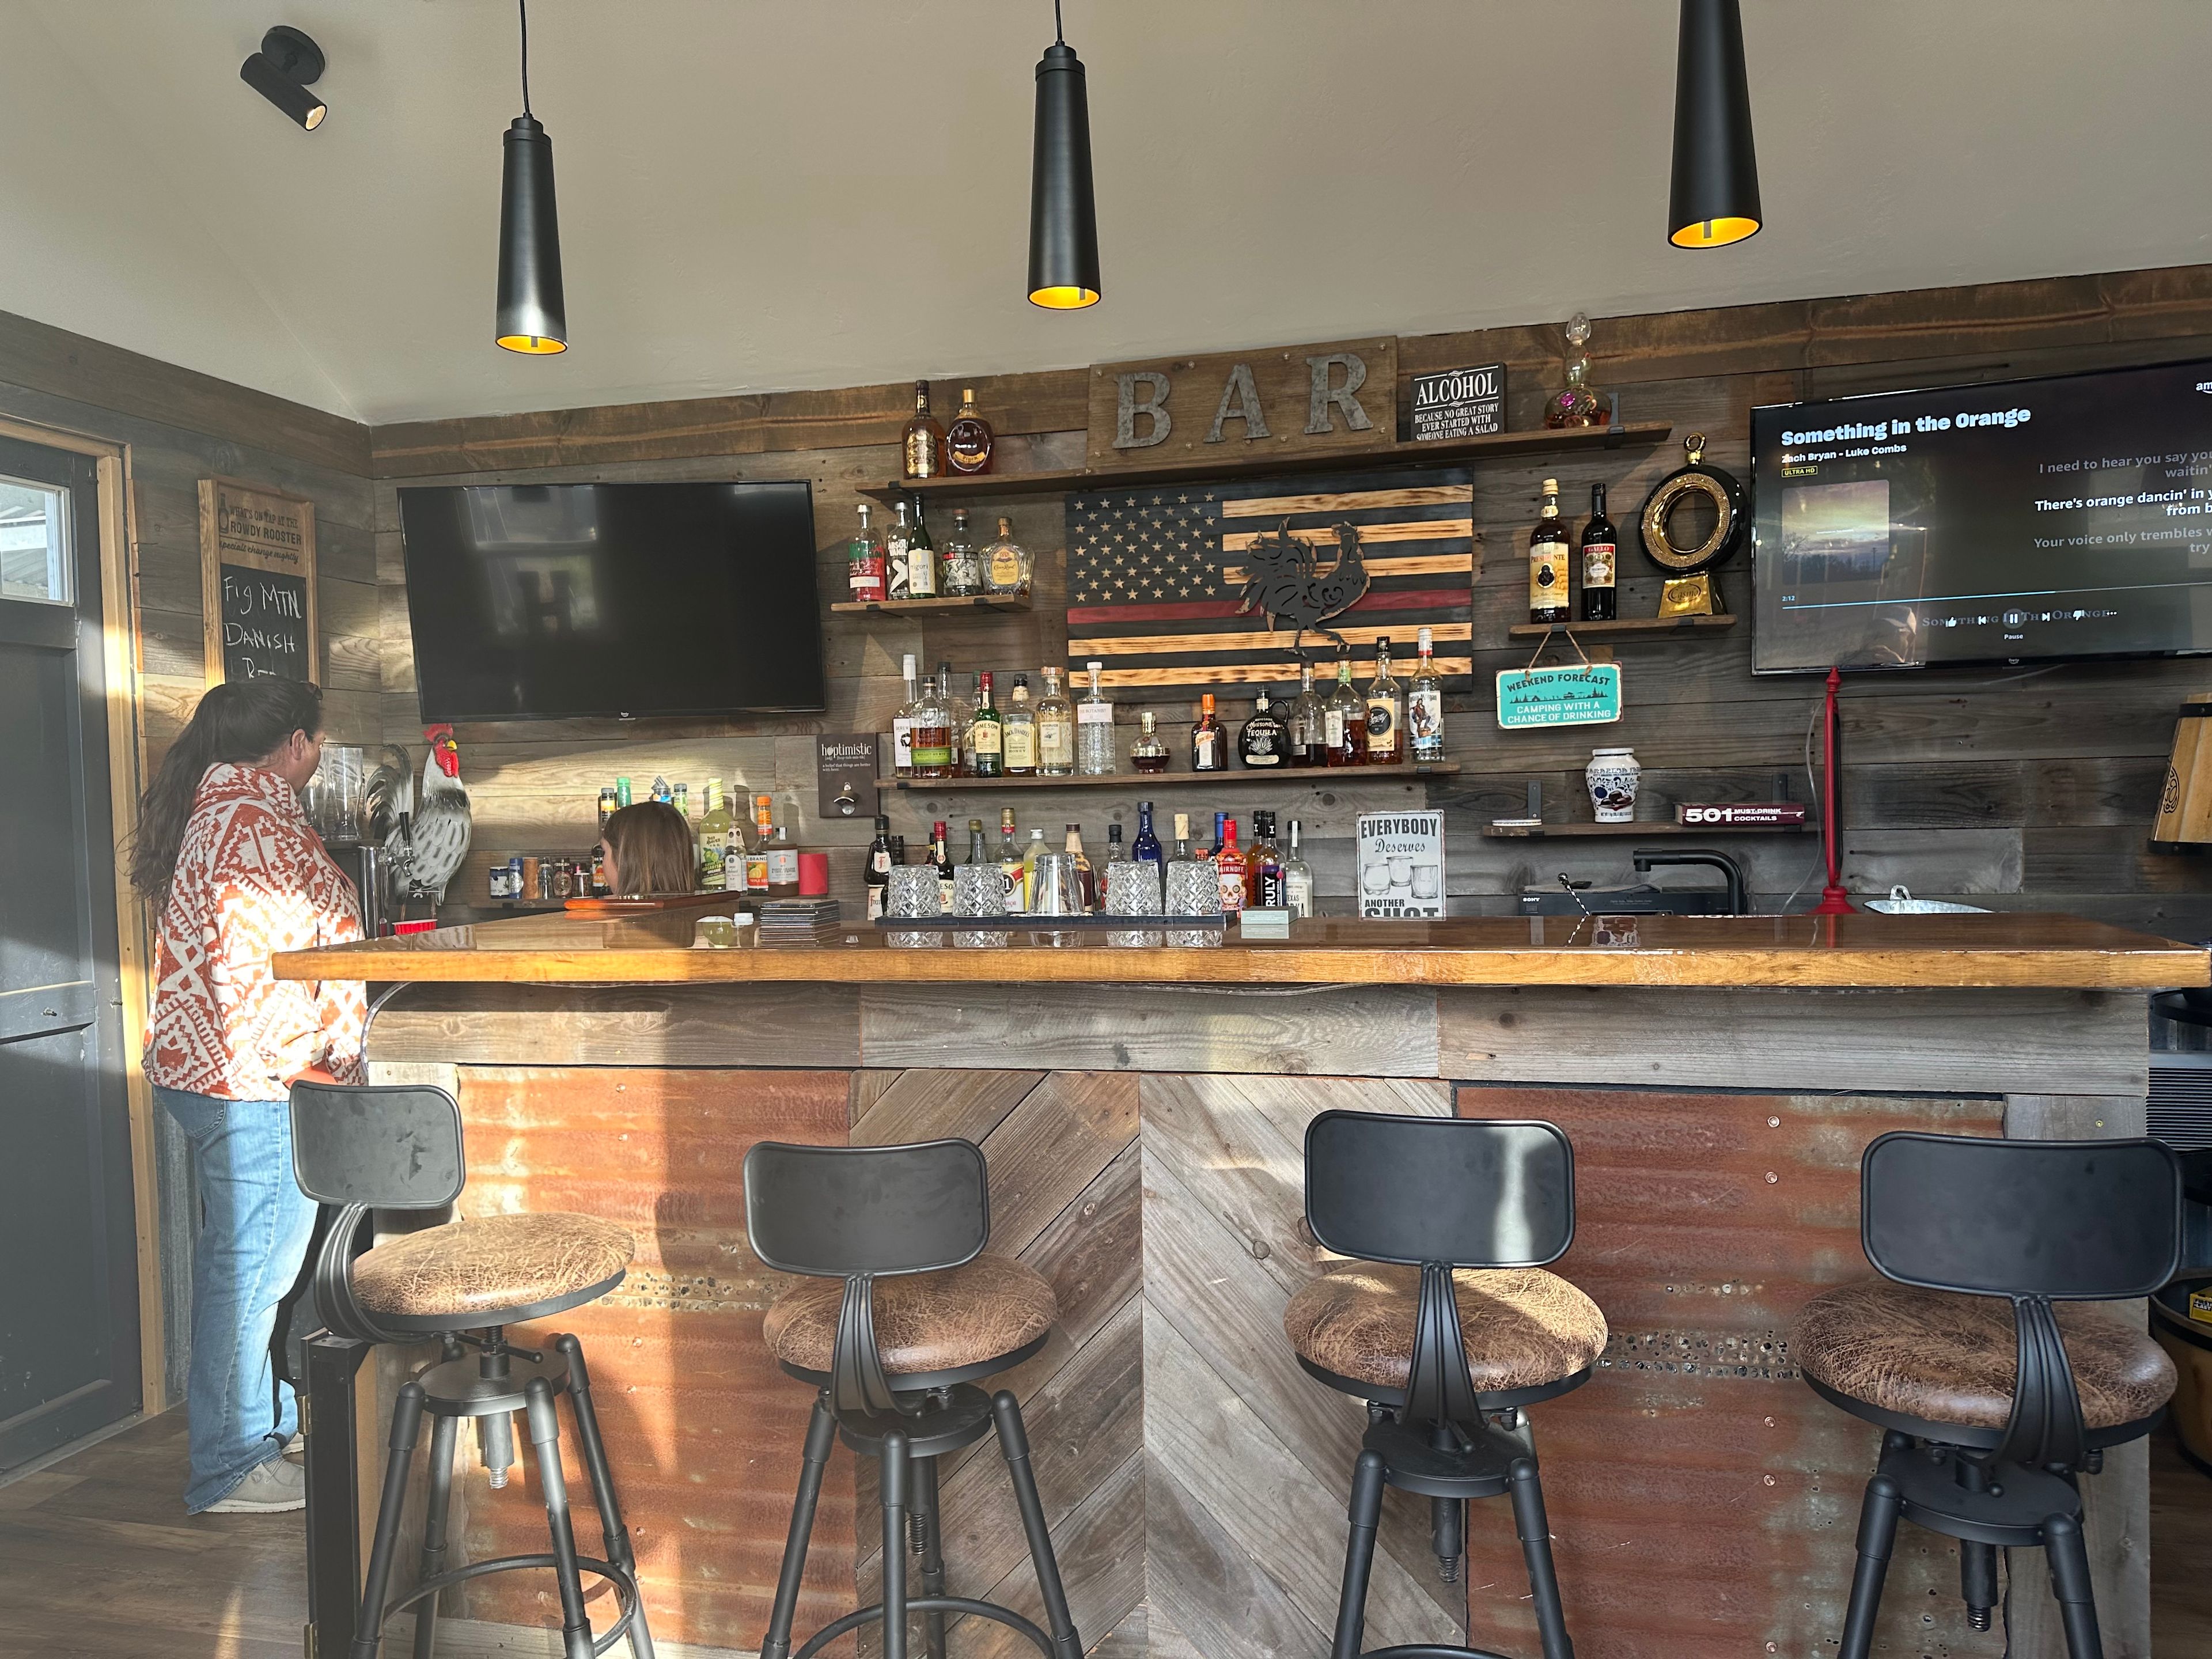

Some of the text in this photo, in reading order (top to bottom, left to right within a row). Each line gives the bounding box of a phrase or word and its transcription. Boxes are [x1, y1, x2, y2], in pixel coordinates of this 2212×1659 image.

[1416, 373, 1498, 405] ALCOHOL
[1415, 403, 1499, 423] BECAUSE NO GREAT STORY
[1416, 423, 1498, 441] SOMEONE EATING A SALAD
[1422, 414, 1491, 432] EVER STARTED WITH
[1781, 408, 2031, 446] Something in the Orange
[1782, 453, 1805, 463] Zach
[1808, 450, 1836, 462] Bryan
[1846, 449, 1869, 457] Luke
[1872, 444, 1907, 455] Combs
[2040, 464, 2043, 474] I
[2048, 460, 2079, 472] need
[2084, 460, 2097, 469] to
[2103, 457, 2132, 468] hear
[2135, 455, 2160, 467] you
[2165, 453, 2187, 463] say
[2165, 464, 2211, 478] waitin'
[2035, 498, 2082, 511] There's
[2086, 494, 2133, 507] orange
[2137, 489, 2187, 503] dancin'
[2191, 488, 2203, 499] in
[2166, 504, 2200, 516] from
[254, 511, 263, 521] ON
[278, 516, 285, 526] AT
[286, 517, 298, 529] THE
[230, 521, 301, 544] ROWDY ROOSTER
[2034, 537, 2064, 548] Your
[2068, 535, 2103, 546] voice
[2107, 531, 2137, 544] only
[2141, 527, 2202, 540] trembles
[220, 541, 299, 565] specials change nightly
[2190, 542, 2210, 554] try
[224, 576, 302, 619] Fig MTN
[1671, 588, 1699, 599] Casino
[223, 622, 294, 653] DANISH
[1507, 673, 1611, 692] WEEKEND FORECAST
[1508, 714, 1547, 724] CHANCE
[1563, 710, 1611, 720] DRINKING
[1517, 703, 1561, 714] CAMPING
[1563, 702, 1590, 711] WITH
[1247, 729, 1277, 737] TEQUILA
[1685, 808, 1732, 823] 501
[1361, 819, 1437, 839] EVERYBODY
[1375, 838, 1425, 853] Deserves
[1264, 877, 1275, 907] RULY
[1365, 899, 1405, 907] ANOTHER
